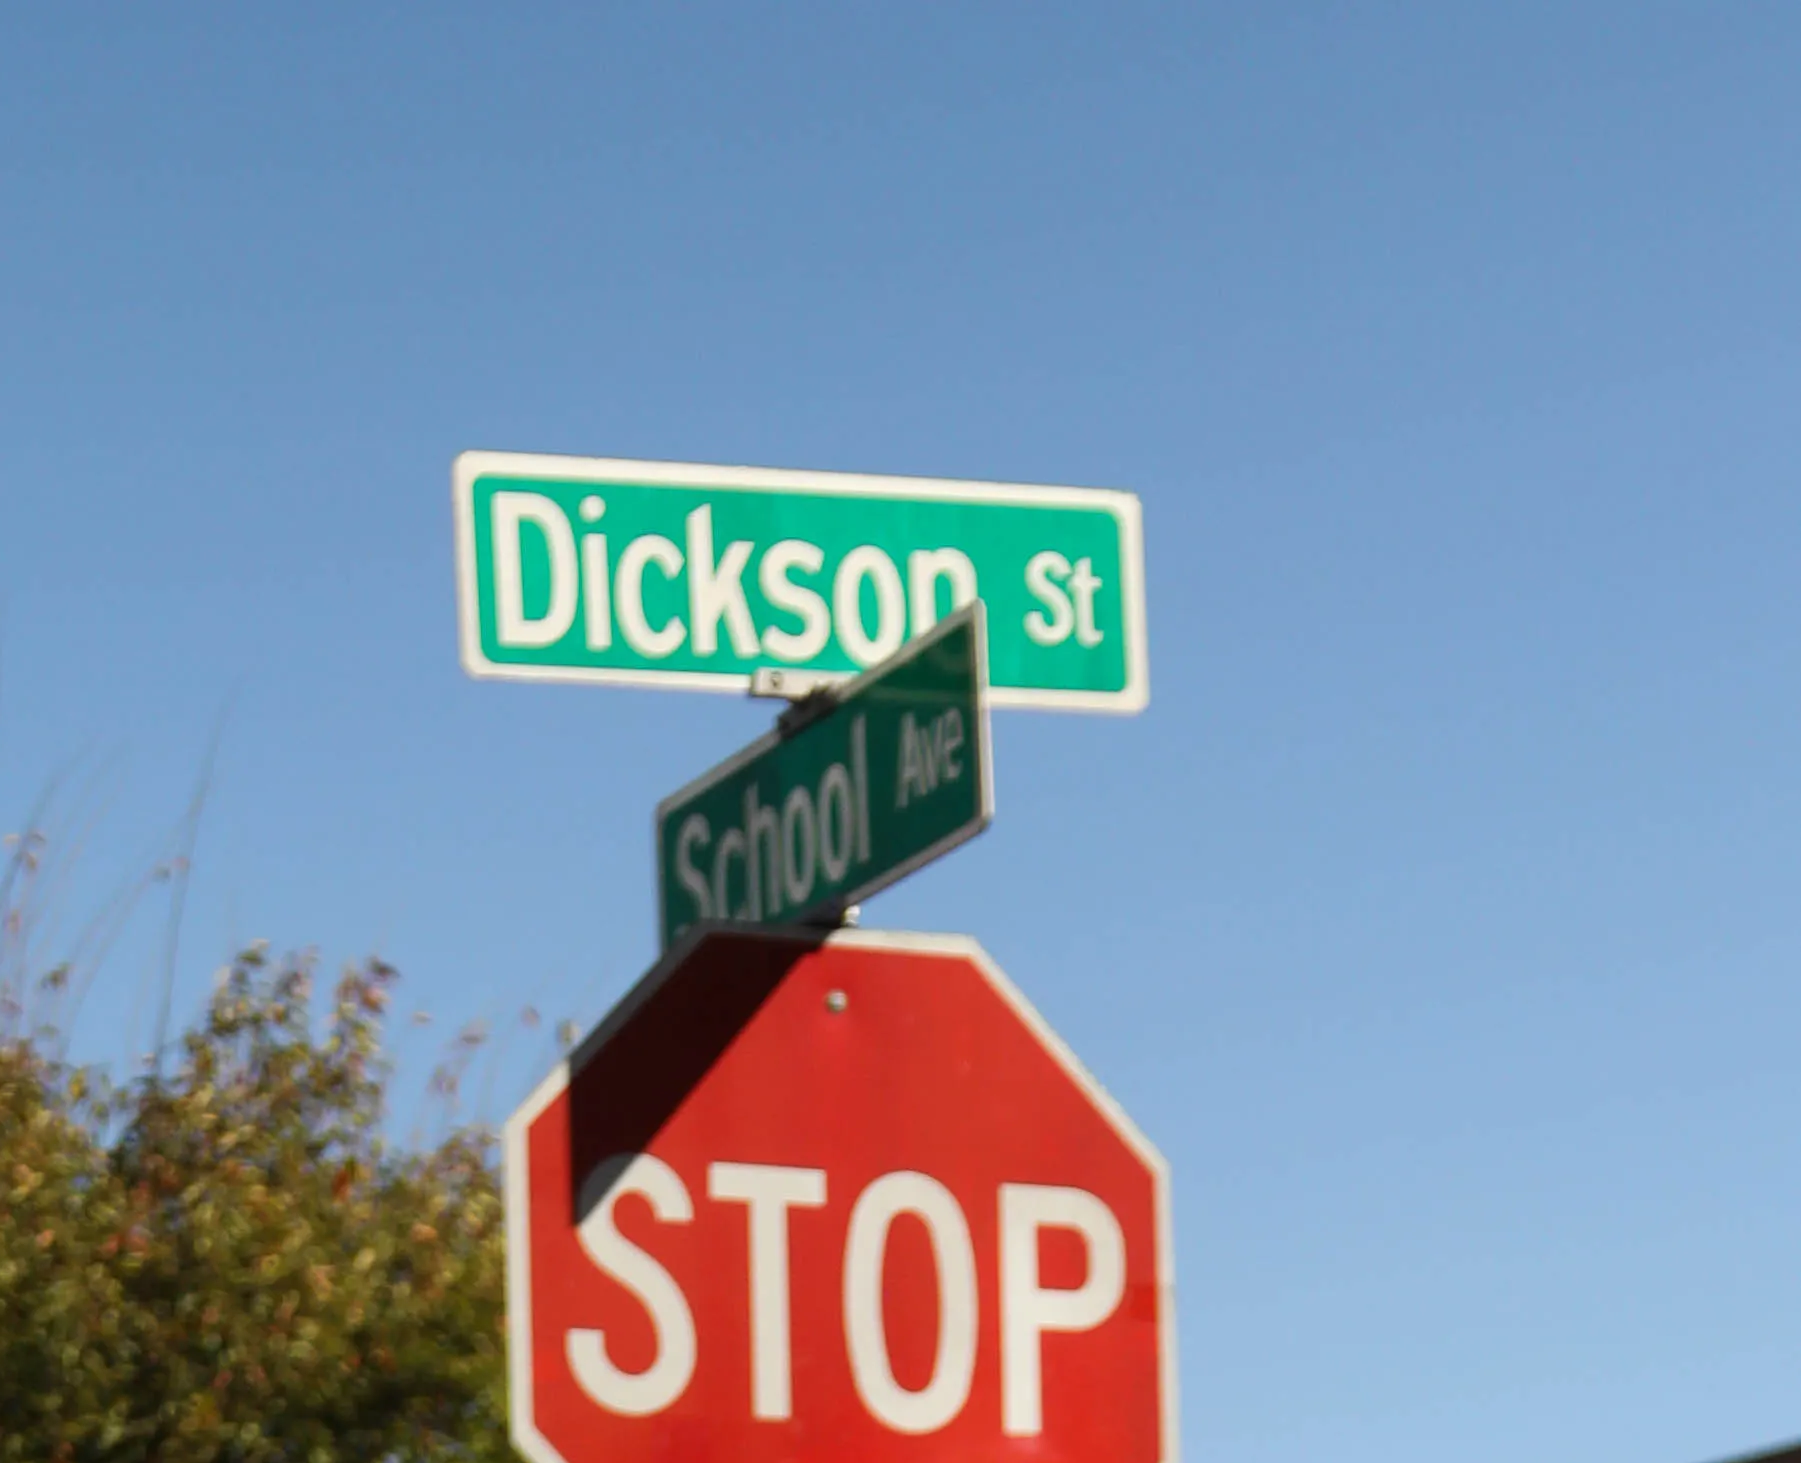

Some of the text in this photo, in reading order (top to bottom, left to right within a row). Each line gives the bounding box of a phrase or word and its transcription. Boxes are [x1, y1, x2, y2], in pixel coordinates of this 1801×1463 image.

[490, 488, 1105, 669] Dickson St
[674, 705, 967, 938] School Ave
[564, 1151, 1128, 1437] STOP
